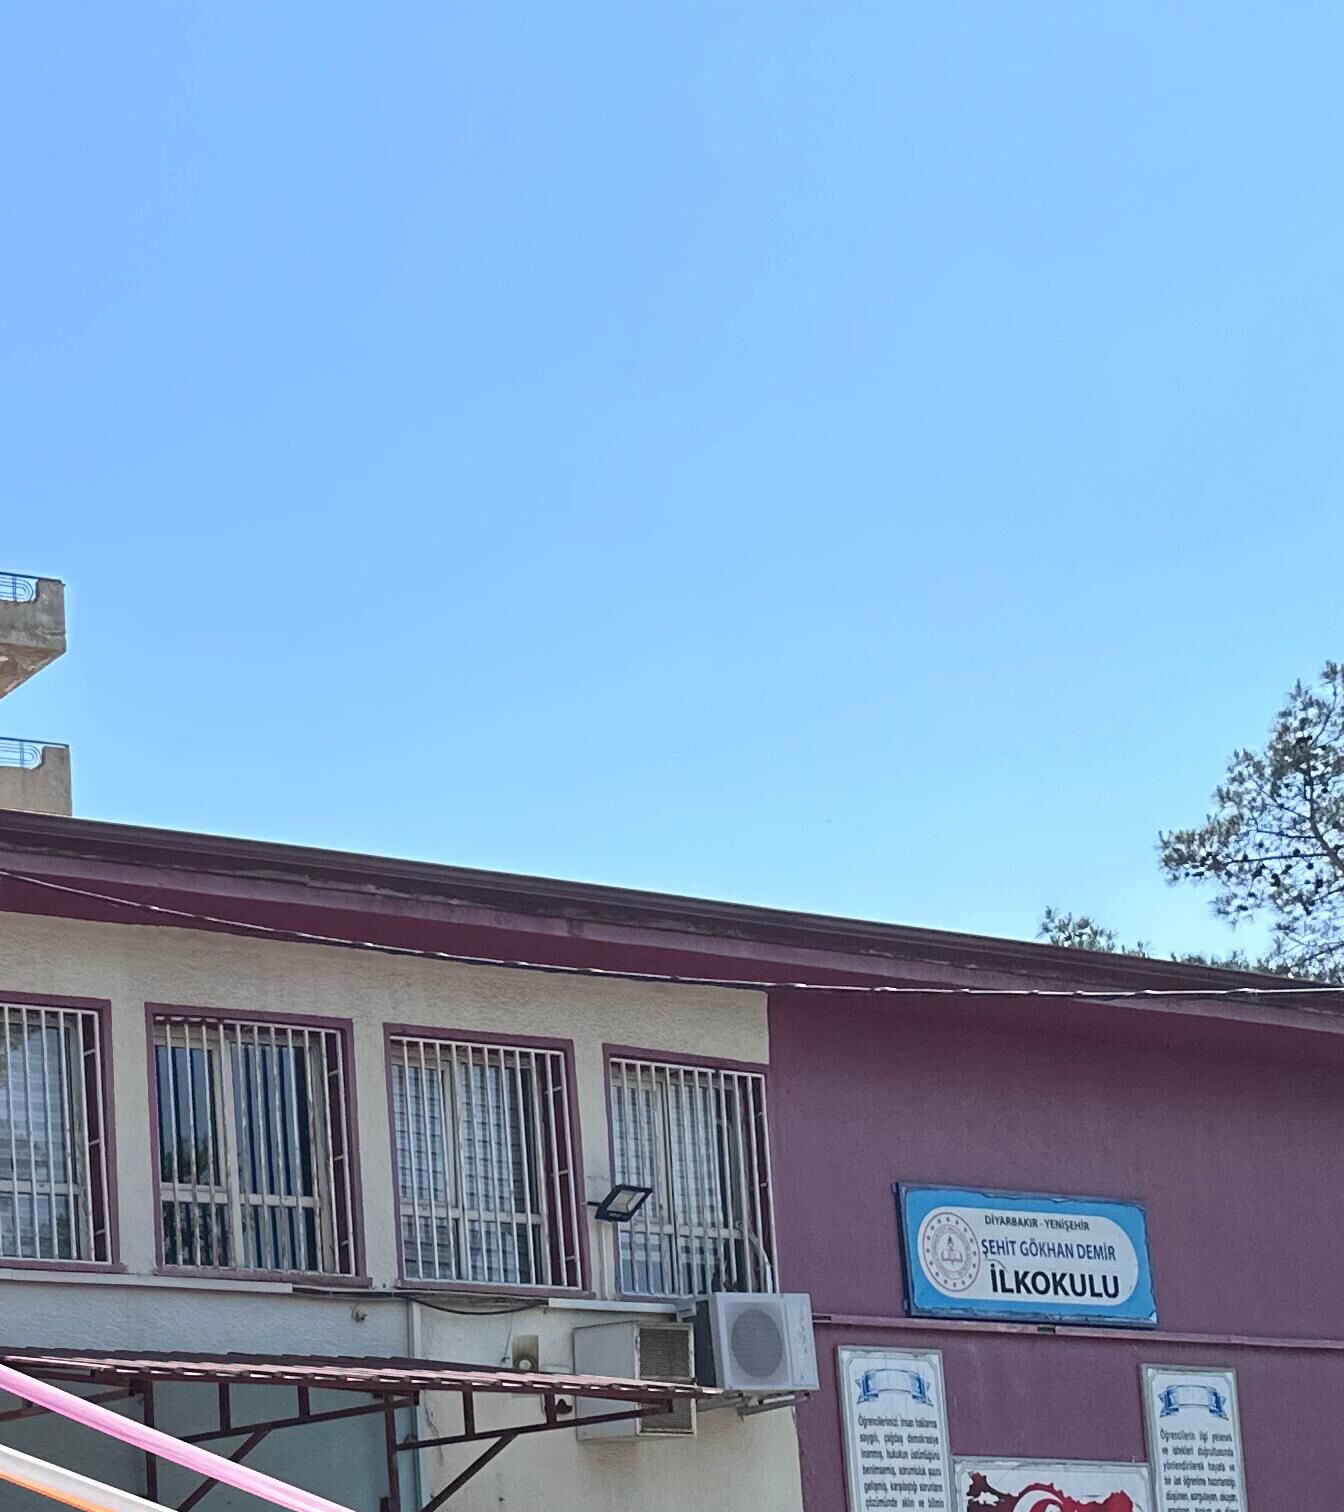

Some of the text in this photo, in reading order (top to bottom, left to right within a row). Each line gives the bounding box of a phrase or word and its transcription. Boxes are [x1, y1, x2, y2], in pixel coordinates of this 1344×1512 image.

[984, 1213, 1038, 1229] DİYARBAKIR
[1045, 1218, 1090, 1232] YENİŞEHİR
[981, 1236, 1116, 1262] ŞEHİT GÖKHAN DEMİR
[990, 1263, 1120, 1299] İLKOKULU
